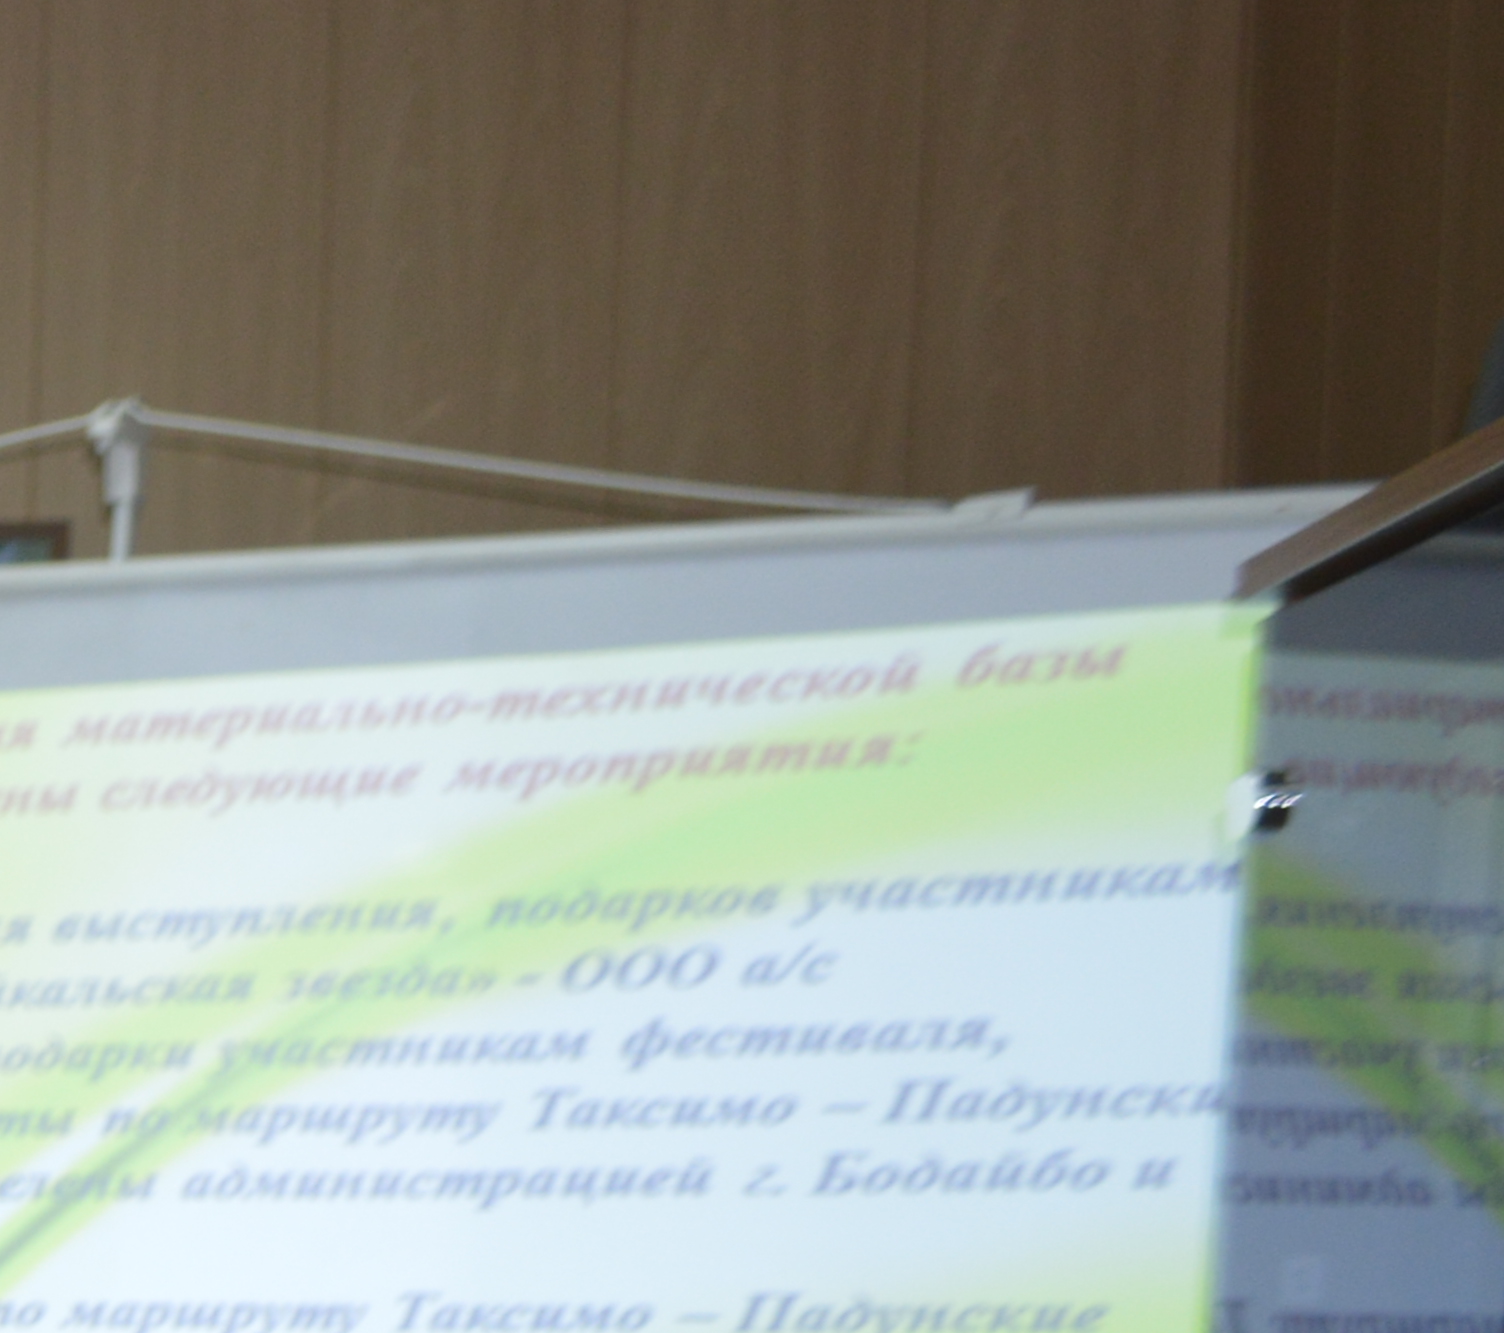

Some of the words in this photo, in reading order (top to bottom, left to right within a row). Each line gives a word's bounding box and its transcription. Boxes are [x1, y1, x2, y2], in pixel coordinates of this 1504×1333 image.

[60, 647, 925, 752] материально-технической
[954, 639, 1133, 693] базы
[97, 757, 424, 818] следующие
[443, 728, 925, 801] мероприятия:
[49, 897, 455, 954] выступления,
[484, 880, 785, 934] подарков
[790, 857, 1245, 927] участникам
[216, 1025, 594, 1078] участникам
[619, 1010, 1013, 1074] фестиваля,
[99, 1105, 178, 1139] по
[194, 1096, 504, 1147] маршруту
[525, 1084, 800, 1135] Таксимо
[879, 1073, 1224, 1134] Падунски
[180, 1154, 717, 1213] администрацией
[740, 1165, 789, 1197] г.
[809, 1145, 1115, 1198] Бодайбо
[1129, 1154, 1182, 1194] и
